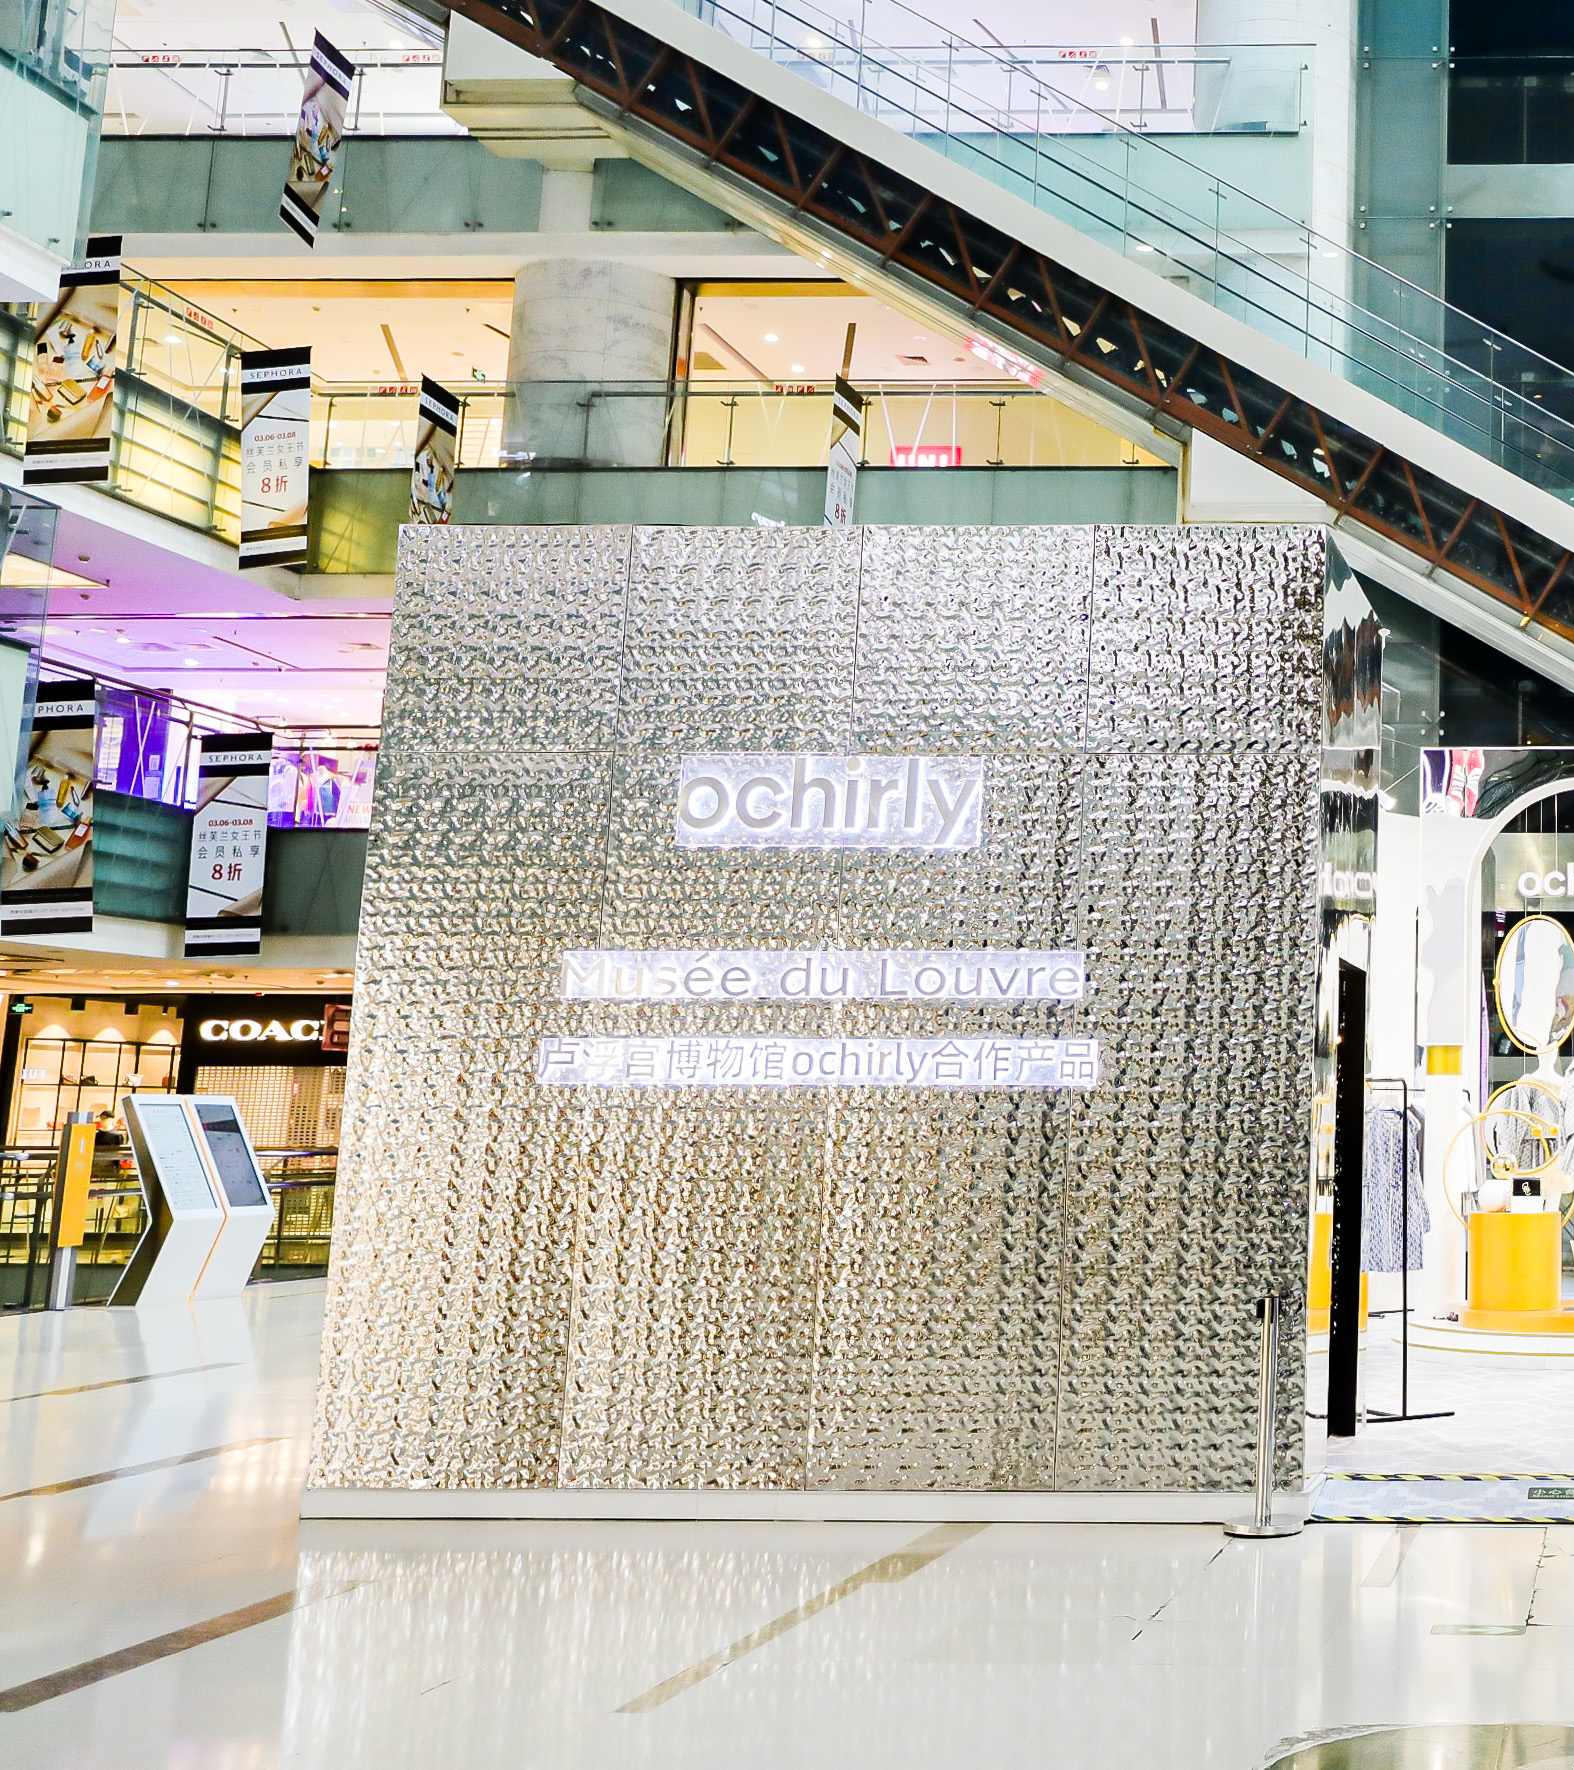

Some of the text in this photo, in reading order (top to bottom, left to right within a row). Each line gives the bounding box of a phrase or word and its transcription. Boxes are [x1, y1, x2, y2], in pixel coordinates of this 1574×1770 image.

[315, 51, 347, 86] SEPHORA
[249, 368, 303, 380] SEPHORA
[424, 396, 455, 422] SEPHORA
[254, 431, 297, 442] 03.06-03.08
[246, 456, 304, 474] 会员私享
[208, 753, 263, 763] SEPHORA
[679, 756, 976, 845] ochirly
[208, 818, 254, 828] 03.06-03.08
[198, 829, 262, 842] 丝芙兰女王节
[197, 844, 261, 860] 会员私享
[561, 952, 1081, 998] Musée du Louvre
[199, 1019, 326, 1041] COAC
[538, 1039, 1097, 1086] 卢浮宫博物馆ochirly合作产品
